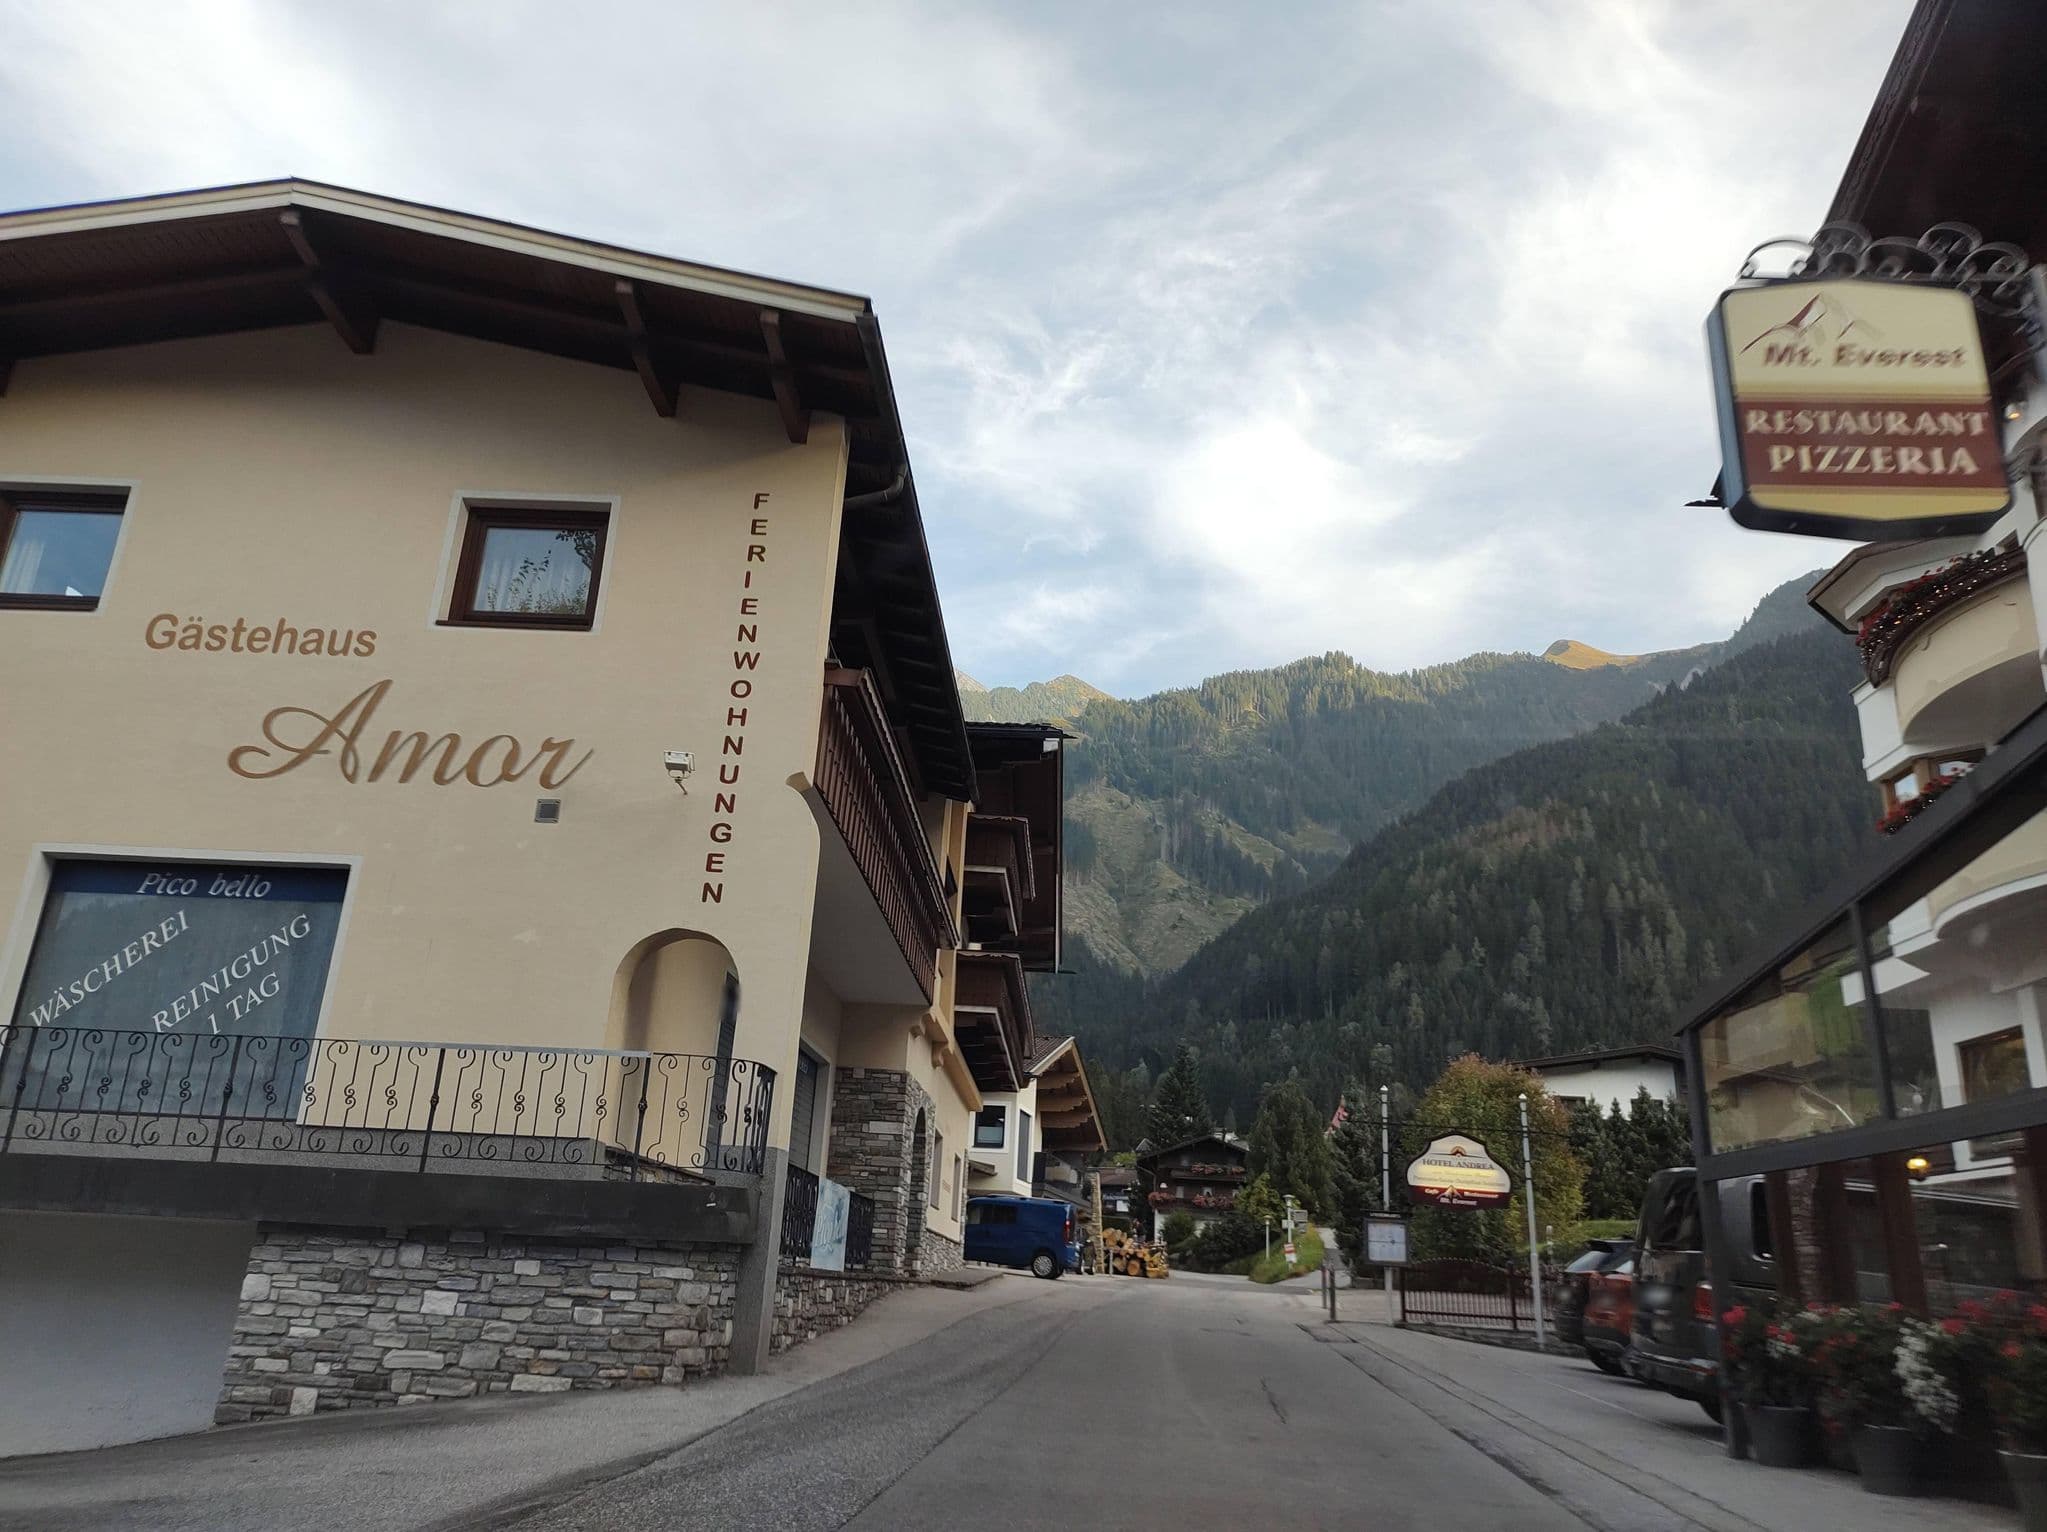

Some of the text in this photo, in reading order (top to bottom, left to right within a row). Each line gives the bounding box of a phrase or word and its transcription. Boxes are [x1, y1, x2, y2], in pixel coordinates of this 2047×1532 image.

[1763, 343, 1966, 369] Mt. Everest
[1745, 409, 1989, 437] RESTAURANT
[1768, 444, 1980, 475] PIZZERIA
[145, 613, 377, 657] Gästehaus
[701, 492, 770, 903] FERIENWOHNUNGEN
[227, 679, 593, 790] Amor
[136, 871, 272, 898] Pico bello
[28, 909, 190, 1028] WÄSCHEREI
[152, 913, 311, 1034] REINIGUNG
[207, 971, 281, 1035] 1 TAG
[1422, 1158, 1495, 1170] HOTEL ANDREA
